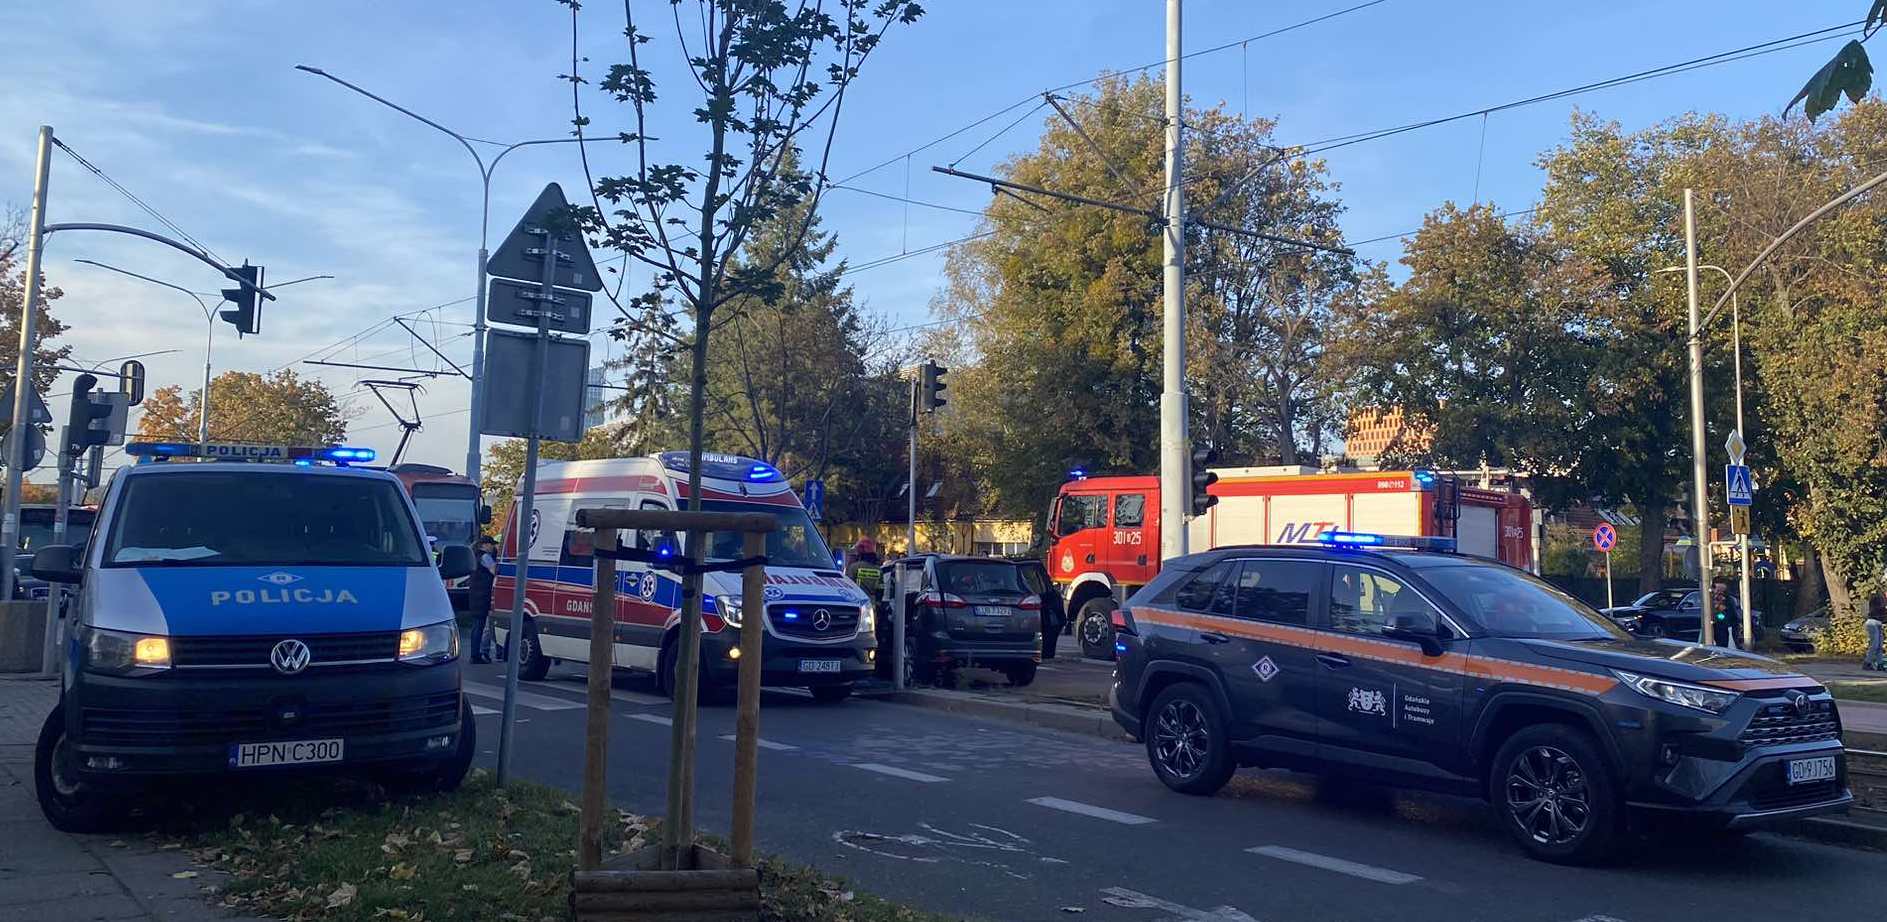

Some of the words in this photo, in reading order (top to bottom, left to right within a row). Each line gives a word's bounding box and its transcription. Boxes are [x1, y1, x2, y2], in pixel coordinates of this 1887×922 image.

[207, 445, 281, 457] POLICJA
[211, 588, 359, 606] POLICJA
[1404, 704, 1430, 715] Autobusy
[241, 744, 287, 765] HPN
[293, 741, 340, 761] C300
[1793, 761, 1804, 779] GD
